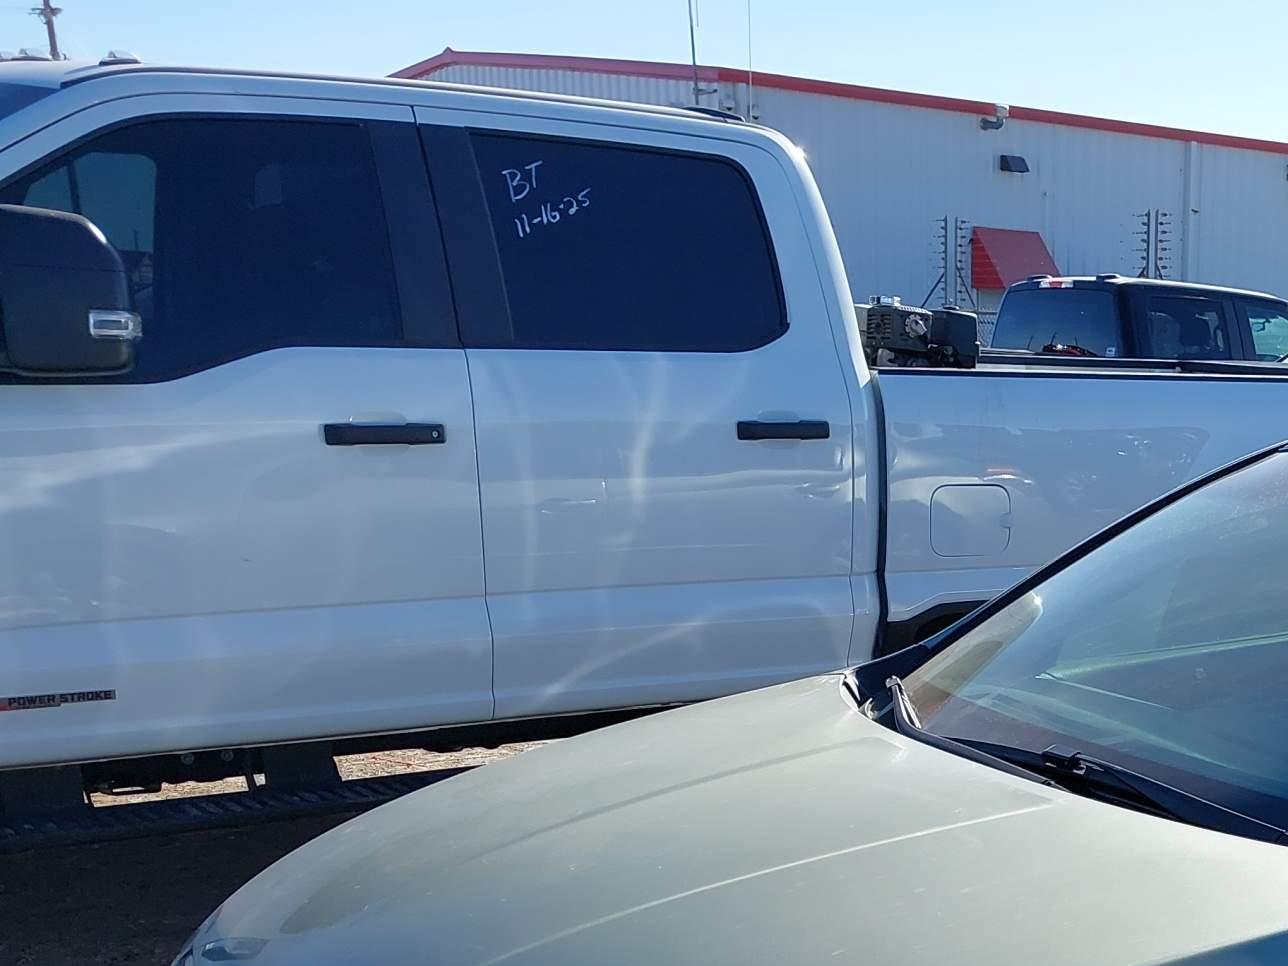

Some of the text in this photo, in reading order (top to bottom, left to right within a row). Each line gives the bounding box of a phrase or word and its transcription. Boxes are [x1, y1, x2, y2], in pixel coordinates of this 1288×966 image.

[501, 160, 543, 203] BT
[8, 689, 112, 707] POWER STROKE
